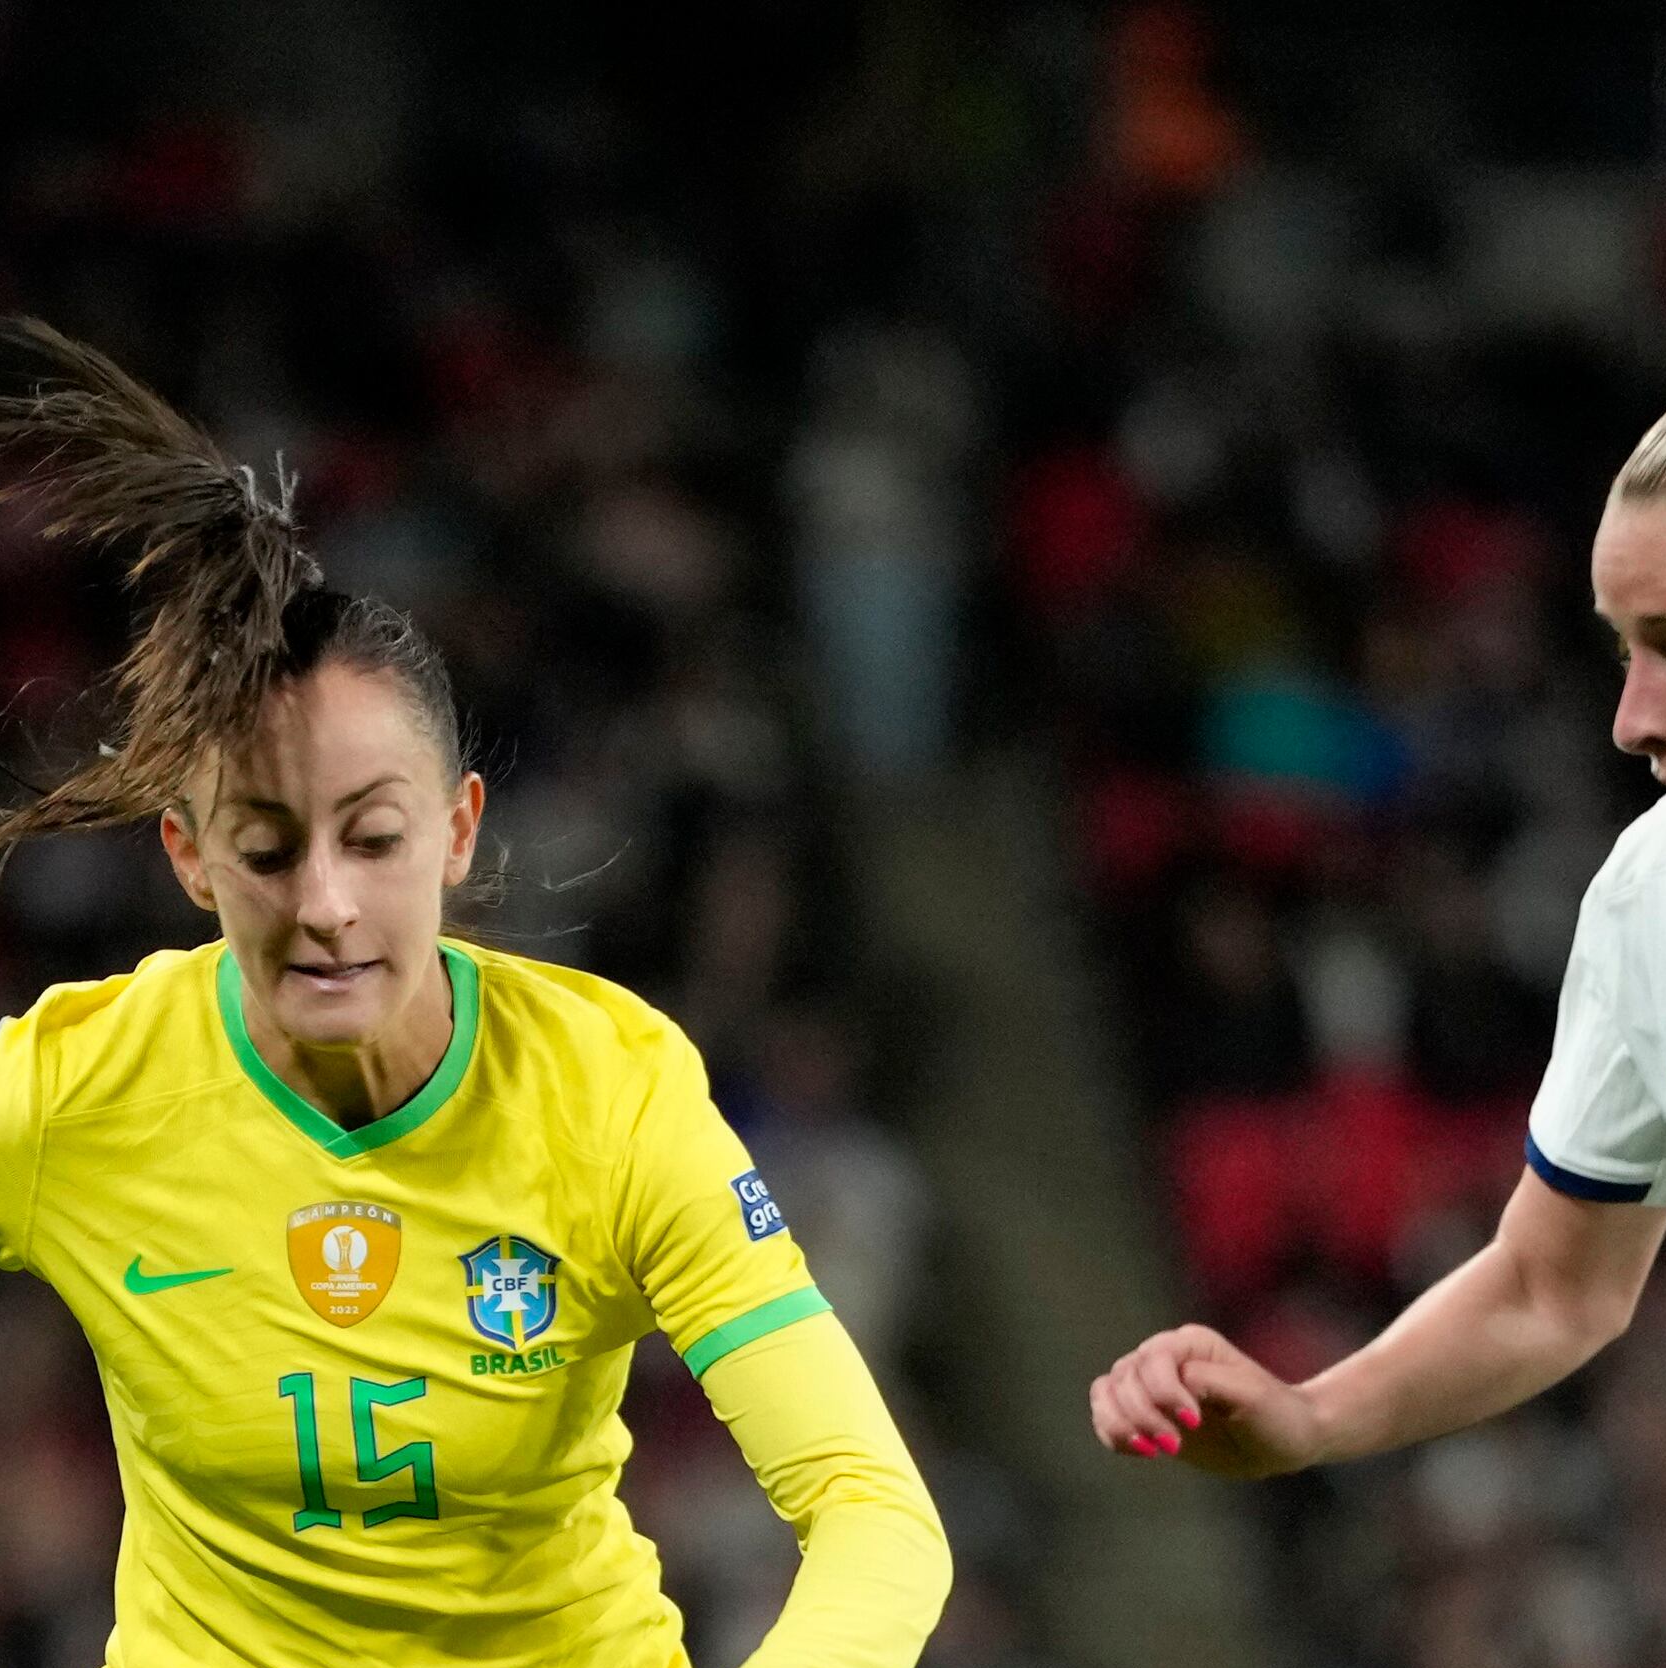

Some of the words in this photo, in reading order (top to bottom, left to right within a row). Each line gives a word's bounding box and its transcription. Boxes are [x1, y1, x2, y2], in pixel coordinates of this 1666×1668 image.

[738, 1179, 770, 1204] Cre
[749, 1201, 782, 1235] gra
[310, 1282, 334, 1290] COPA
[492, 1277, 528, 1292] CBF
[329, 1305, 359, 1314] 2022
[470, 1345, 565, 1375] BRASIL
[278, 1372, 439, 1533] 15
